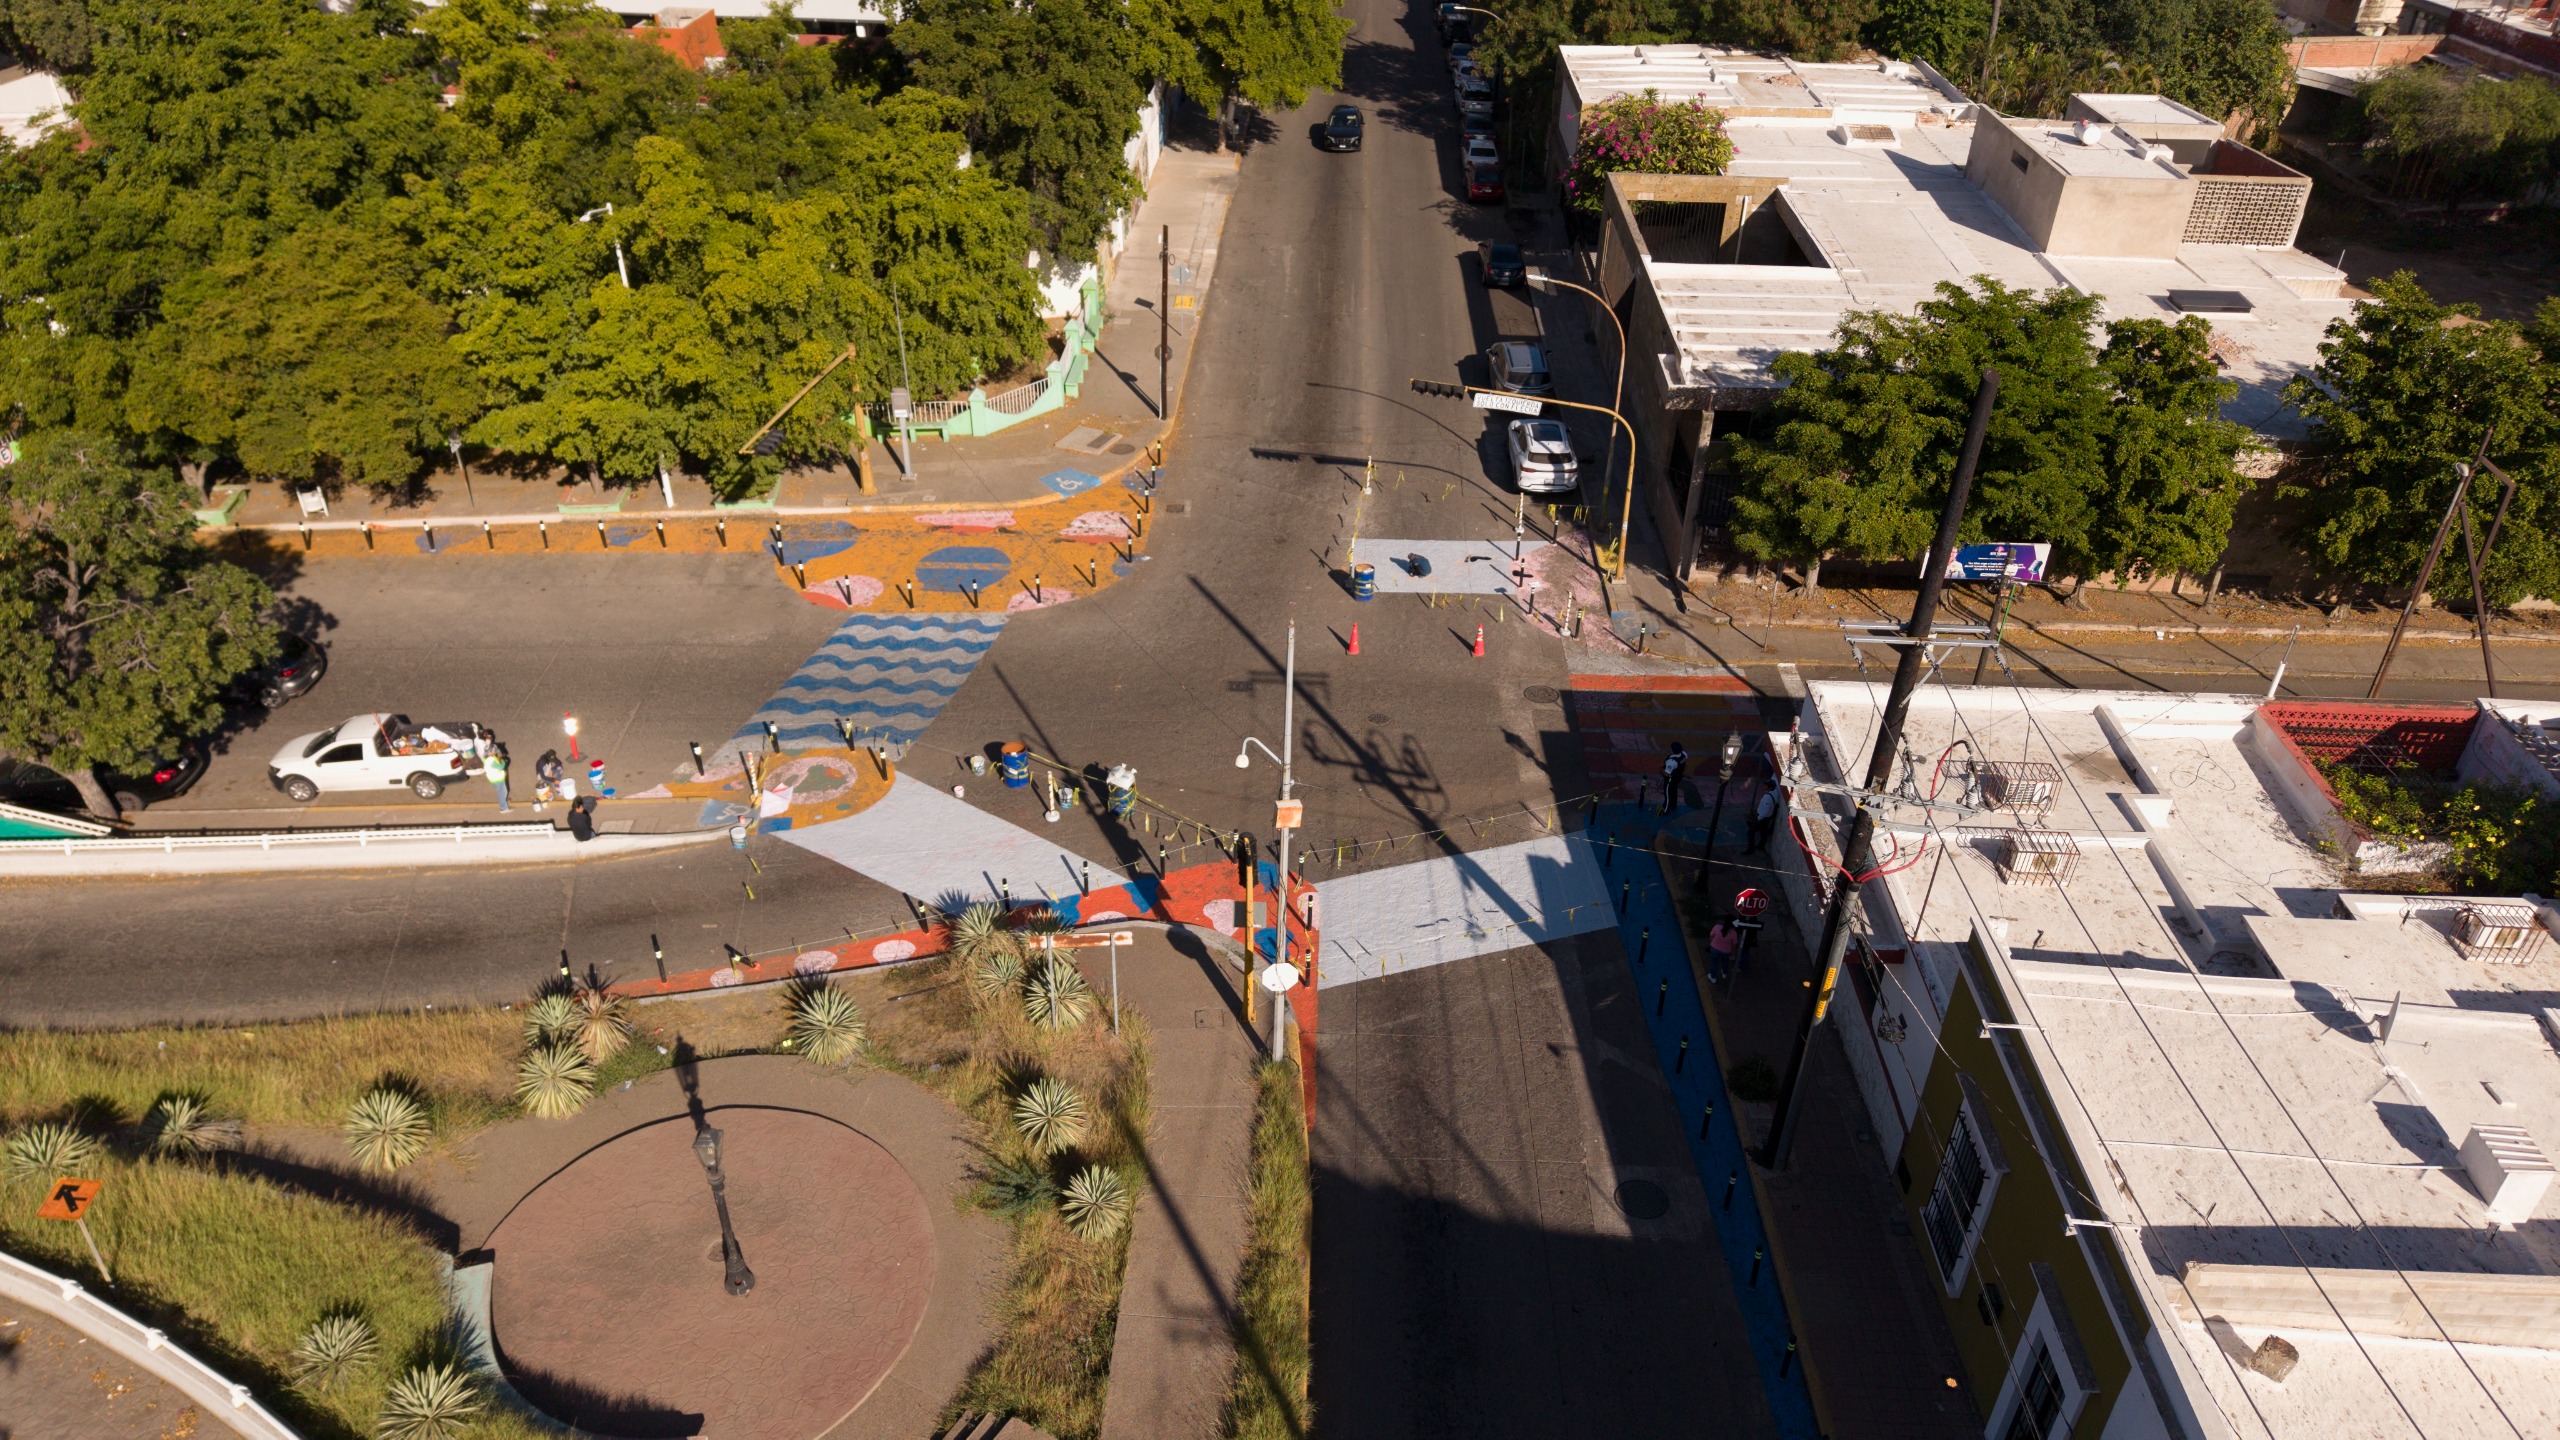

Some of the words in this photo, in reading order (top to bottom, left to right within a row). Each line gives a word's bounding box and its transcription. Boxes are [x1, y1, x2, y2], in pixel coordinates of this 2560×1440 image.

[1505, 398, 1539, 408] IZQUIERDA
[1511, 404, 1538, 413] FLECHA
[1737, 897, 1767, 908] ALTO
